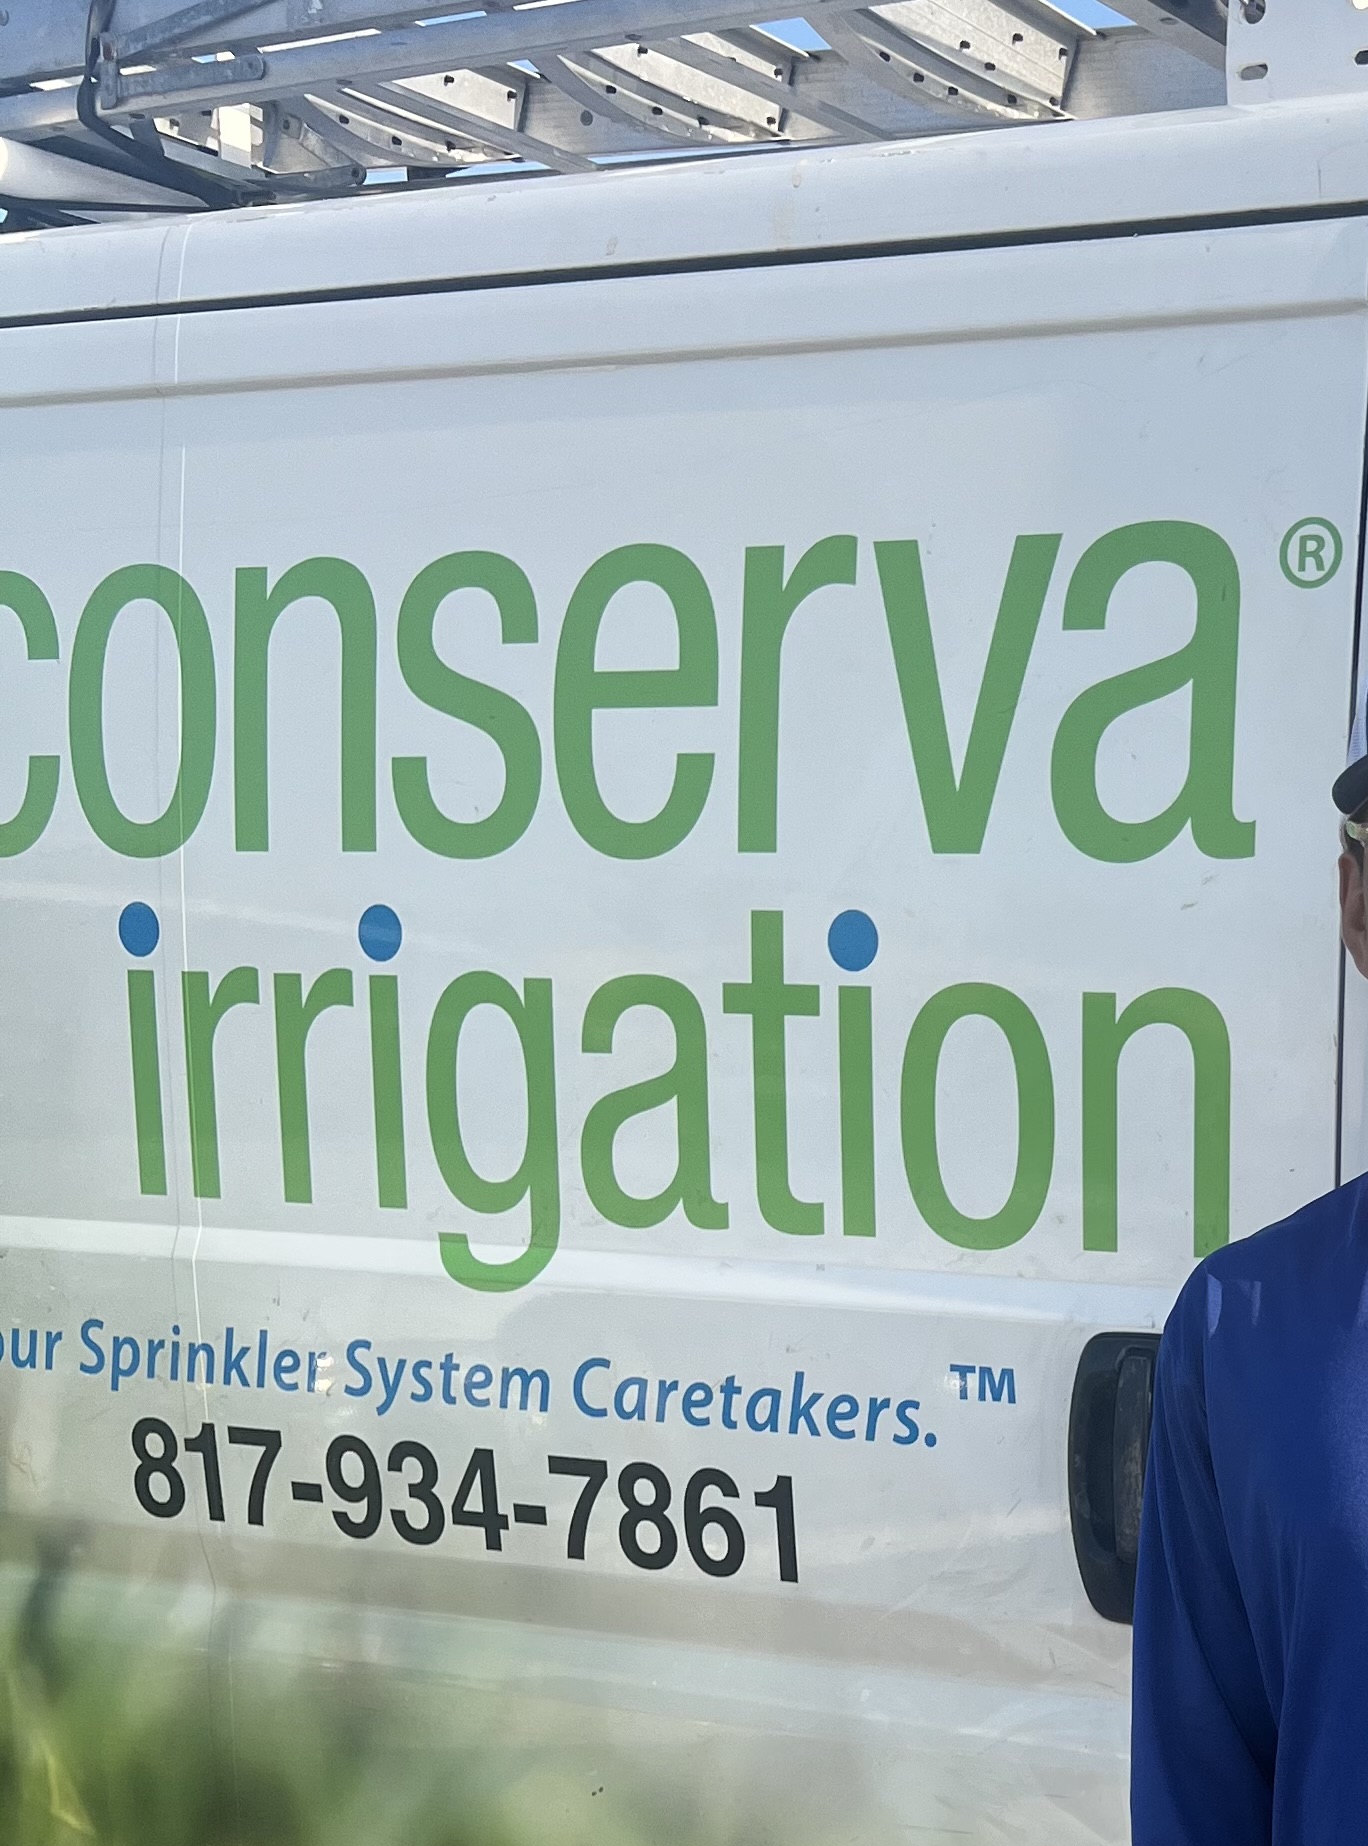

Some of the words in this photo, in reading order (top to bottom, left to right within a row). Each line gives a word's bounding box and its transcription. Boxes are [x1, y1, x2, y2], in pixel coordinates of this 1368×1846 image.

[118, 902, 1232, 1295] irrigation
[0, 1328, 63, 1371] ur
[79, 1319, 329, 1392] Sprinkler
[344, 1339, 551, 1416] System
[572, 1357, 938, 1448] Caretakers.
[131, 1417, 799, 1584] 817-934-7861
